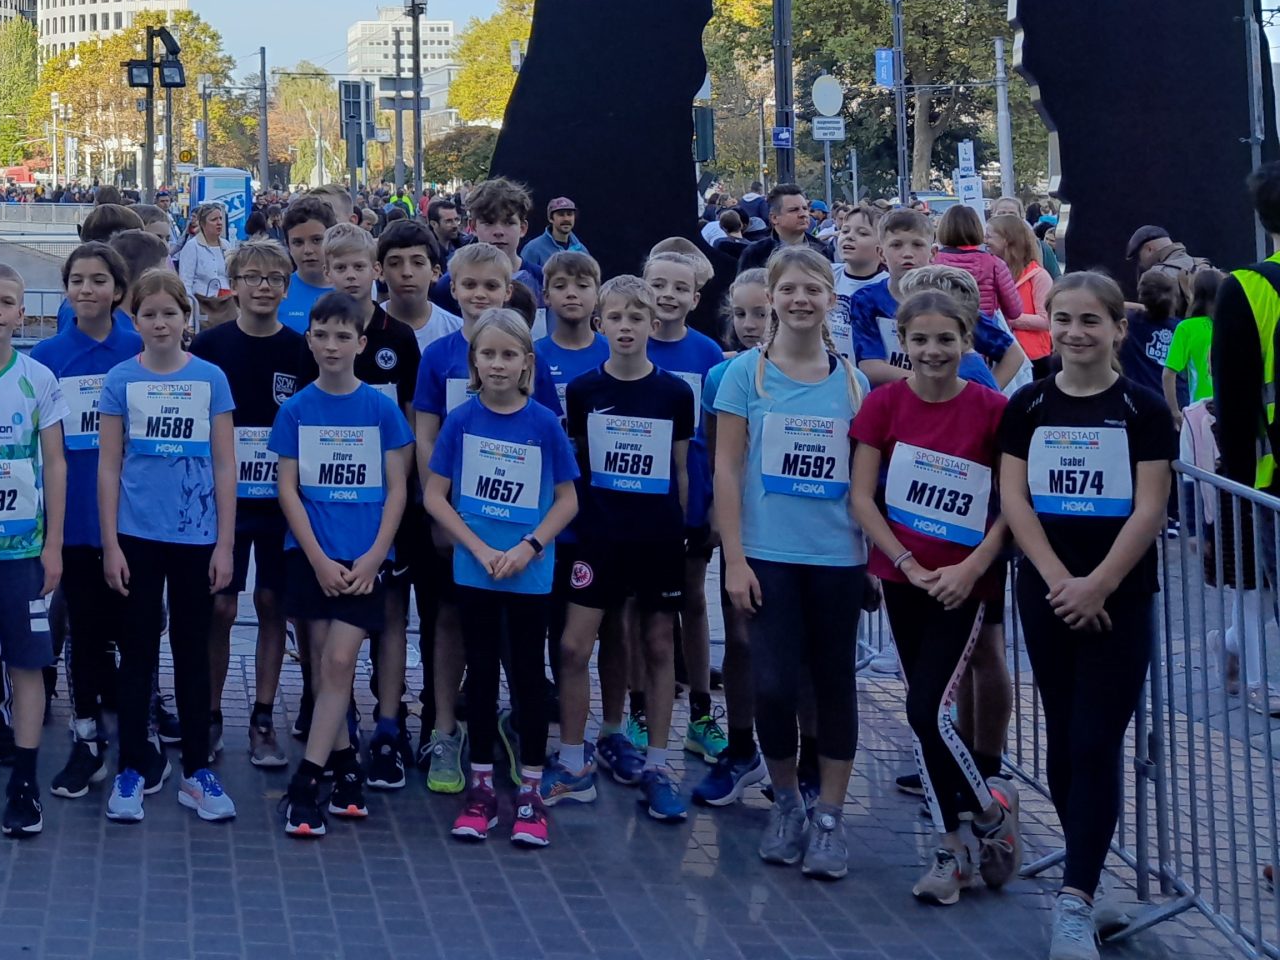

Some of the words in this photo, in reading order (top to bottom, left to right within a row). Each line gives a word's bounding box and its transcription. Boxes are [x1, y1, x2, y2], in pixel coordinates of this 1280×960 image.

[147, 383, 193, 391] SPORTSTADT
[161, 405, 180, 414] Laura
[145, 416, 194, 439] M588
[606, 418, 653, 429] SPORTSTADT
[784, 417, 834, 429] SPORTSTADT
[319, 430, 365, 439] SPORTSTADT
[1044, 431, 1100, 440] SPORTSTADT
[155, 443, 183, 453] HOKA
[480, 440, 527, 456] SPORTSTADT
[615, 440, 643, 451] Laurenz
[794, 441, 826, 453] Veronika
[254, 450, 266, 459] Tom
[333, 452, 353, 461] Ettore
[604, 451, 653, 476] M589
[781, 453, 836, 480] M592
[915, 451, 970, 472] SPORTSTADT
[1060, 456, 1085, 467] Isabel
[318, 463, 367, 485] M656
[494, 467, 506, 477] Ina
[613, 479, 642, 489] HOKA
[1049, 469, 1104, 495] M574
[248, 486, 274, 495] HOKA
[475, 475, 524, 504] M657
[792, 482, 825, 494] HOKA
[329, 490, 358, 500] HOKA
[906, 480, 973, 517] M1133
[481, 504, 510, 518] HOKA
[1061, 501, 1095, 512] HOKA
[912, 518, 947, 536] HOKA
